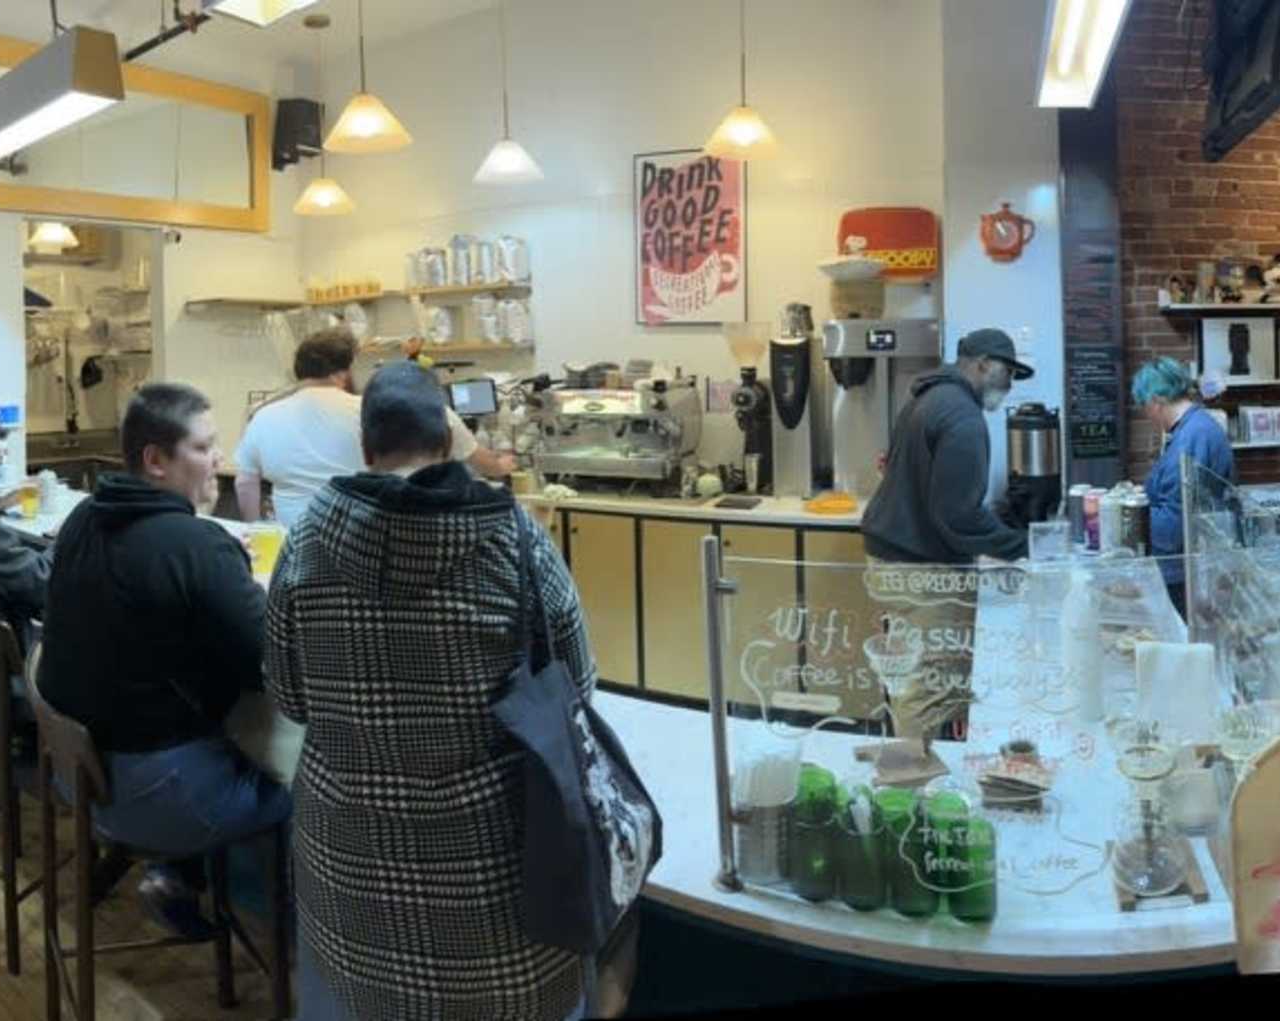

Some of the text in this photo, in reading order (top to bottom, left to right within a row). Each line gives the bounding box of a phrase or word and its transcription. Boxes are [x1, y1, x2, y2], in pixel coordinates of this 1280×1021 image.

[644, 184, 721, 230] GOOD
[641, 208, 734, 273] COFFEE
[768, 607, 852, 656] Wifi
